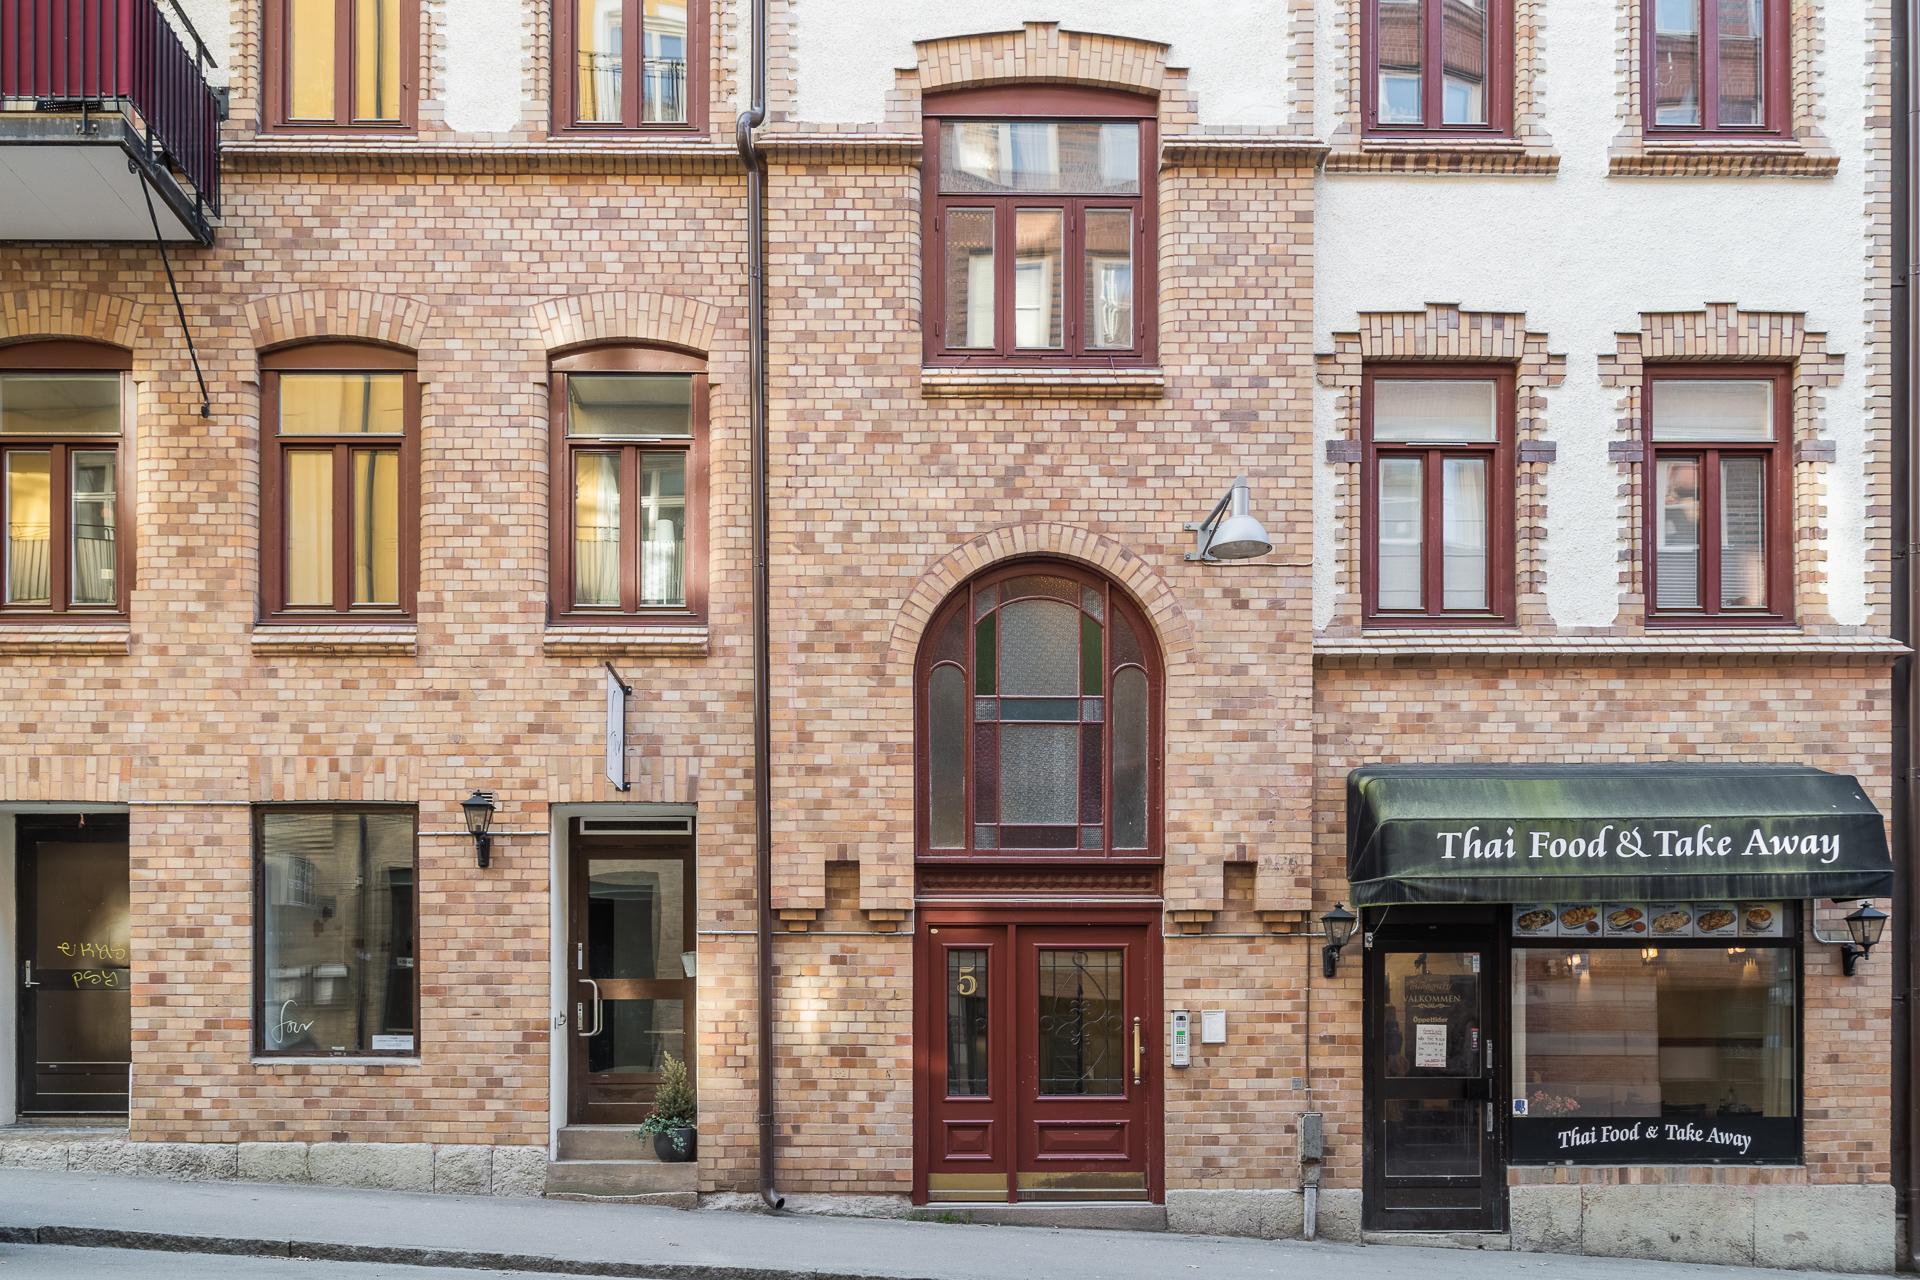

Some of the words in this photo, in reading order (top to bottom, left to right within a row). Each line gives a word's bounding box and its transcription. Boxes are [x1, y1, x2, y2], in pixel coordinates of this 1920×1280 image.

[1437, 826, 1516, 859] Thai
[1528, 824, 1614, 858] Food
[1616, 826, 1651, 858] &
[1652, 824, 1732, 858] Take
[1741, 828, 1840, 864] Away
[957, 965, 977, 996] 5
[1557, 1126, 1598, 1149] Thai
[1600, 1121, 1642, 1143] Food
[1645, 1125, 1659, 1139] &
[1664, 1122, 1704, 1142] Take
[1706, 1127, 1752, 1155] Away
